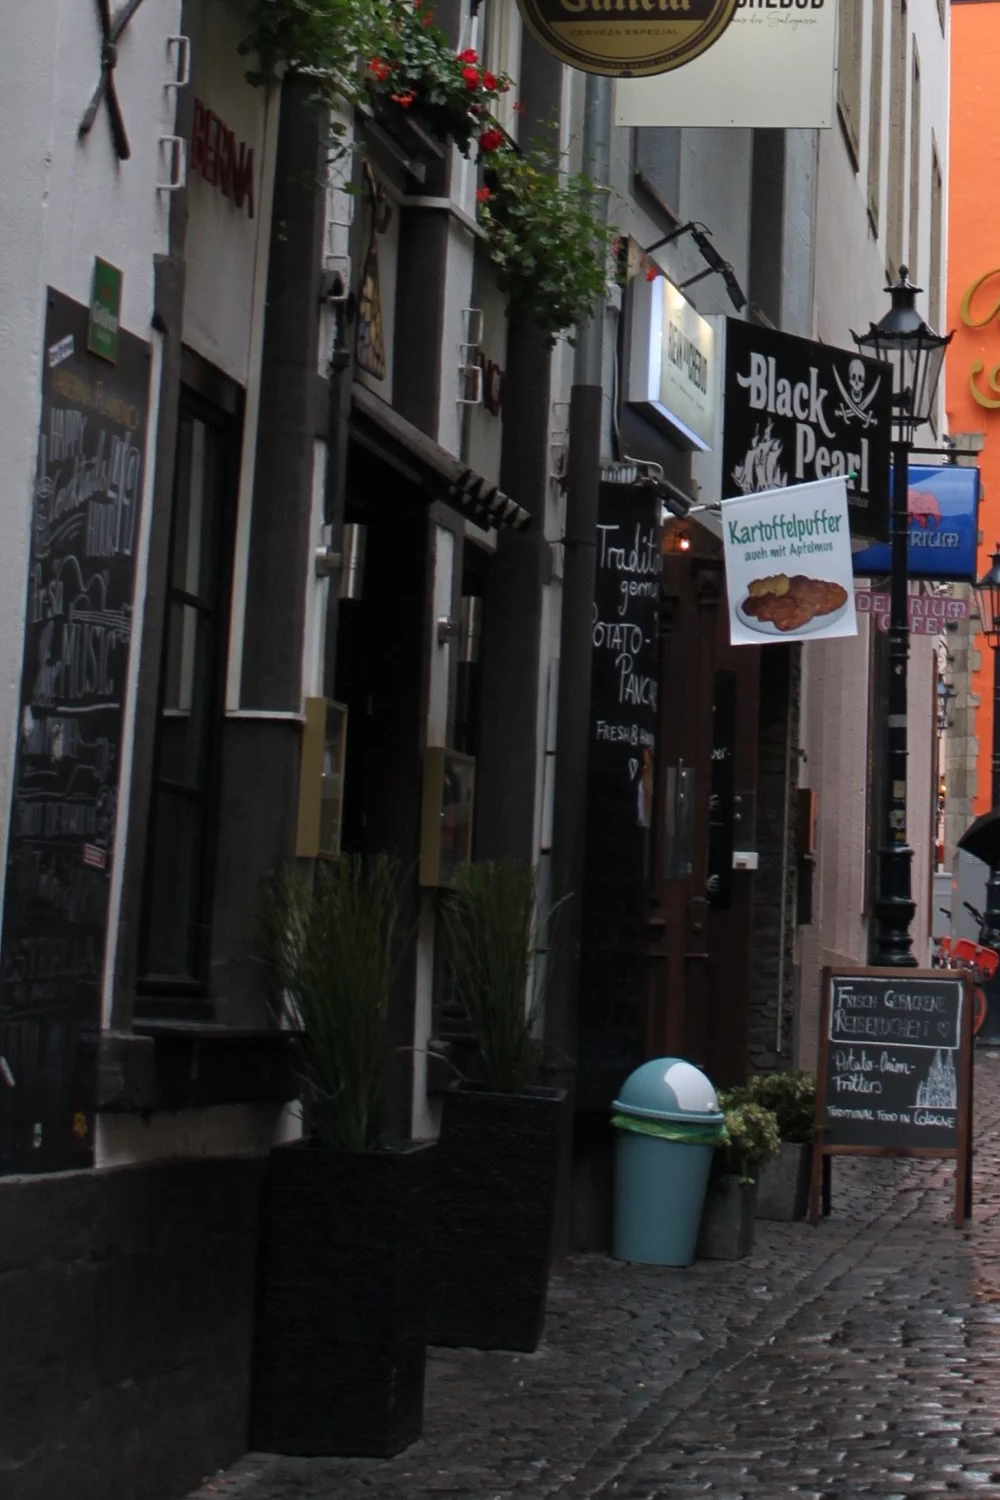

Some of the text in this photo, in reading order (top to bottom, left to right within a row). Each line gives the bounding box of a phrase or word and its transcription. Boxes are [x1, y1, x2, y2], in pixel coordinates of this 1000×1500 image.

[569, 28, 681, 37] CERVEZA ESPECIAL
[736, 352, 836, 440] Black
[795, 421, 870, 494] Pearl
[728, 508, 843, 546] Kartoffelpuffer
[745, 540, 834, 563] auch mit Apfelmus
[837, 986, 878, 1009] FRISCH
